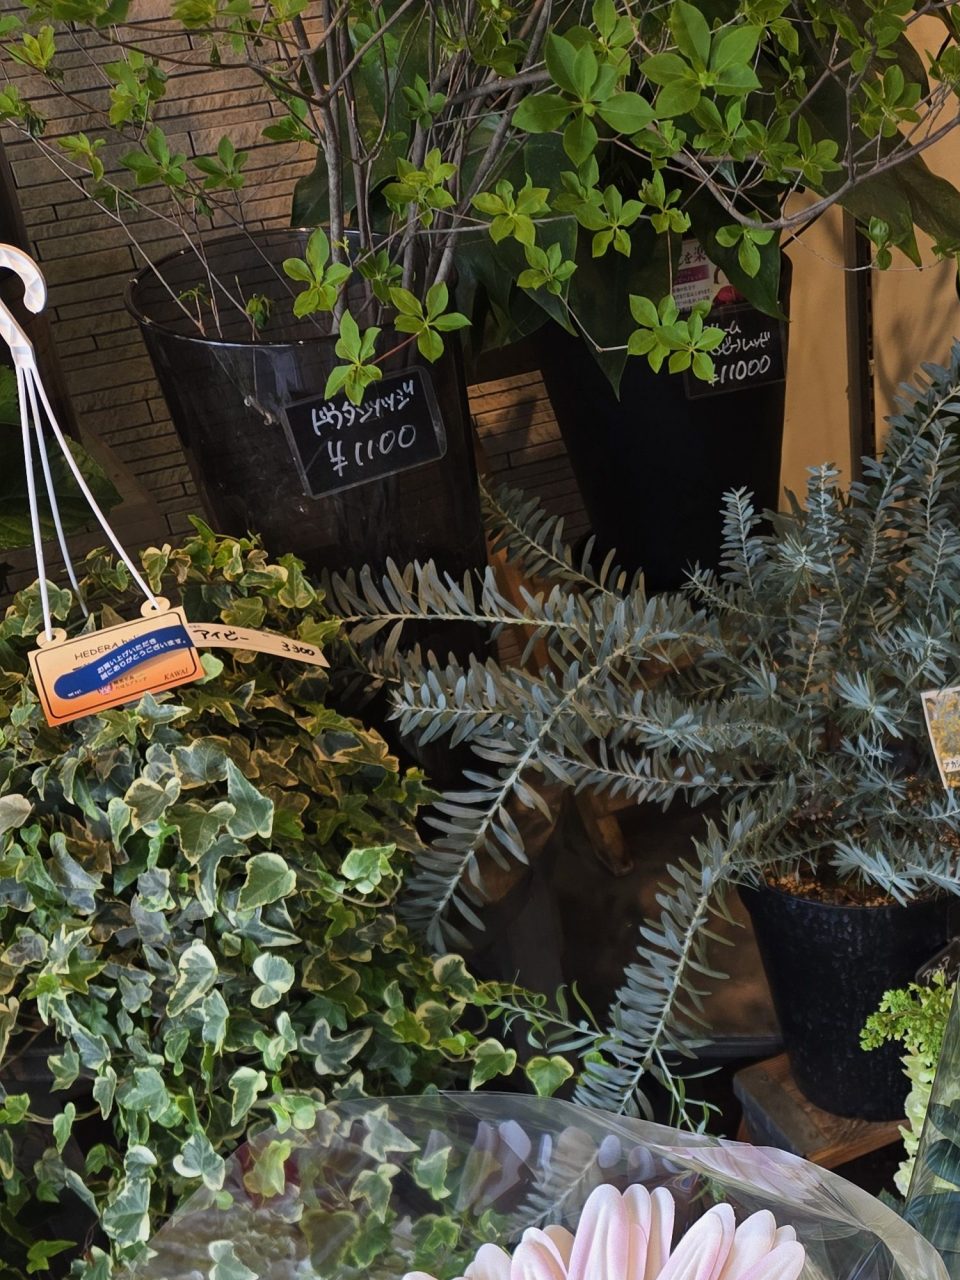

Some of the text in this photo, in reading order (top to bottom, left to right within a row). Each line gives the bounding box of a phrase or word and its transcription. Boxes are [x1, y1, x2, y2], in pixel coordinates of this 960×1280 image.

[327, 424, 417, 477] ¥1100
[192, 628, 250, 642] アイビー
[281, 641, 316, 657] 3300
